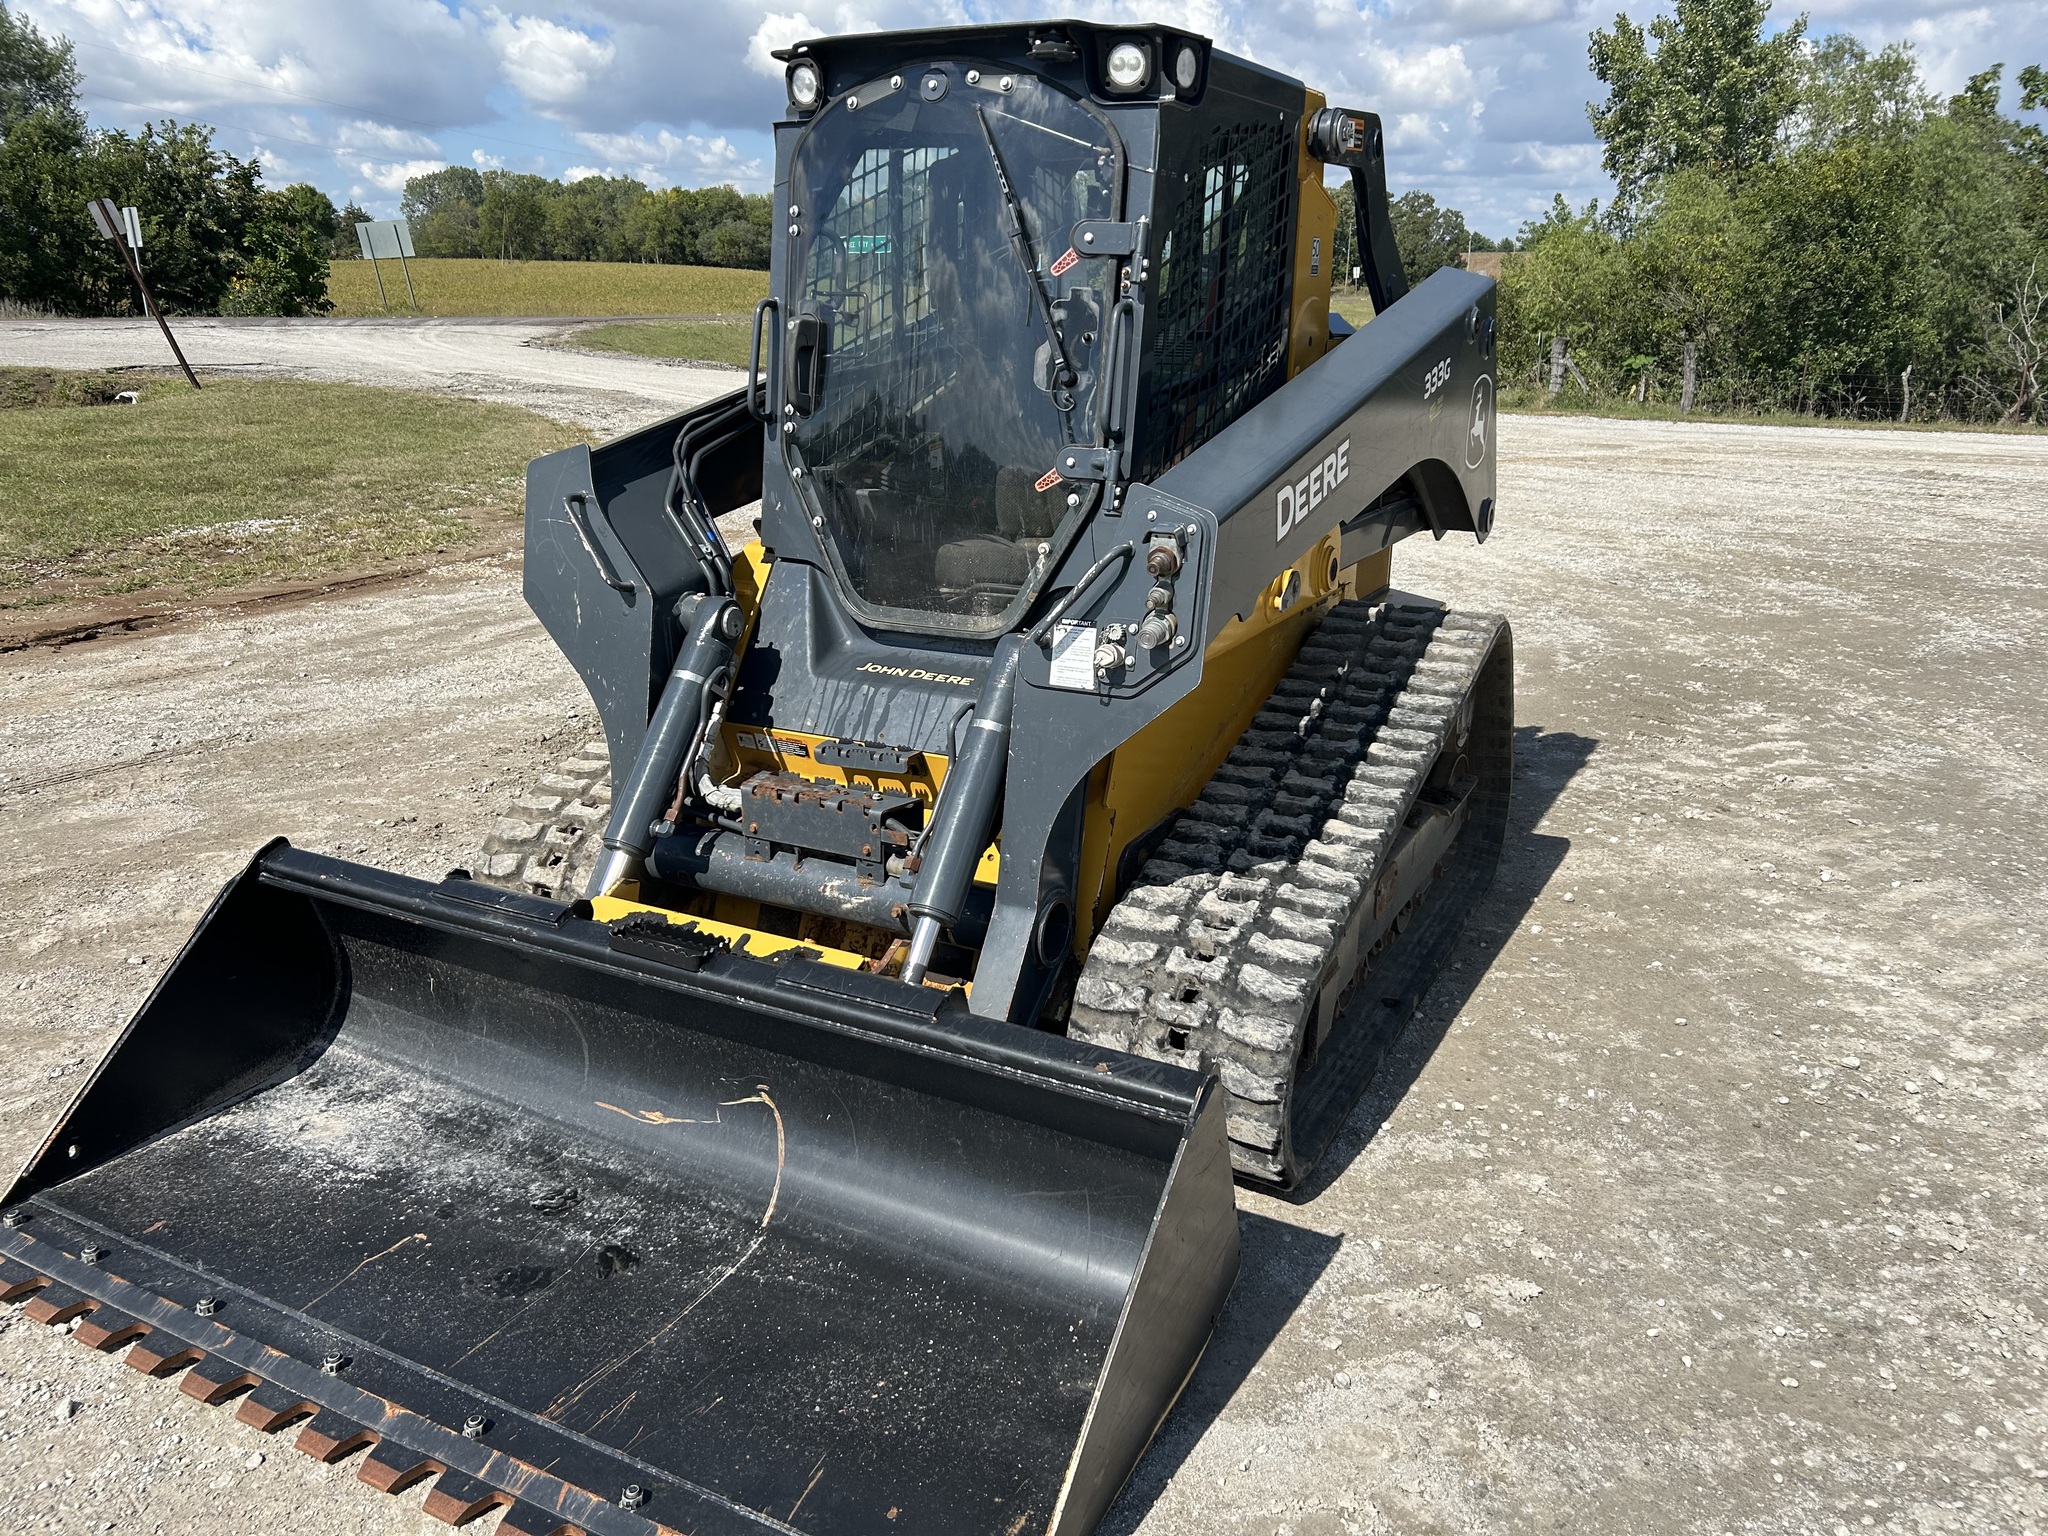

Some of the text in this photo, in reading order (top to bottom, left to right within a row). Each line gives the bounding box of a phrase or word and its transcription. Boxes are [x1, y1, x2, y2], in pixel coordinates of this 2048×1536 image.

[1424, 357, 1451, 400] 333G
[1276, 438, 1350, 543] DEERE
[1061, 618, 1092, 627] IMPORTANT
[856, 662, 975, 686] JOHN DEERE
